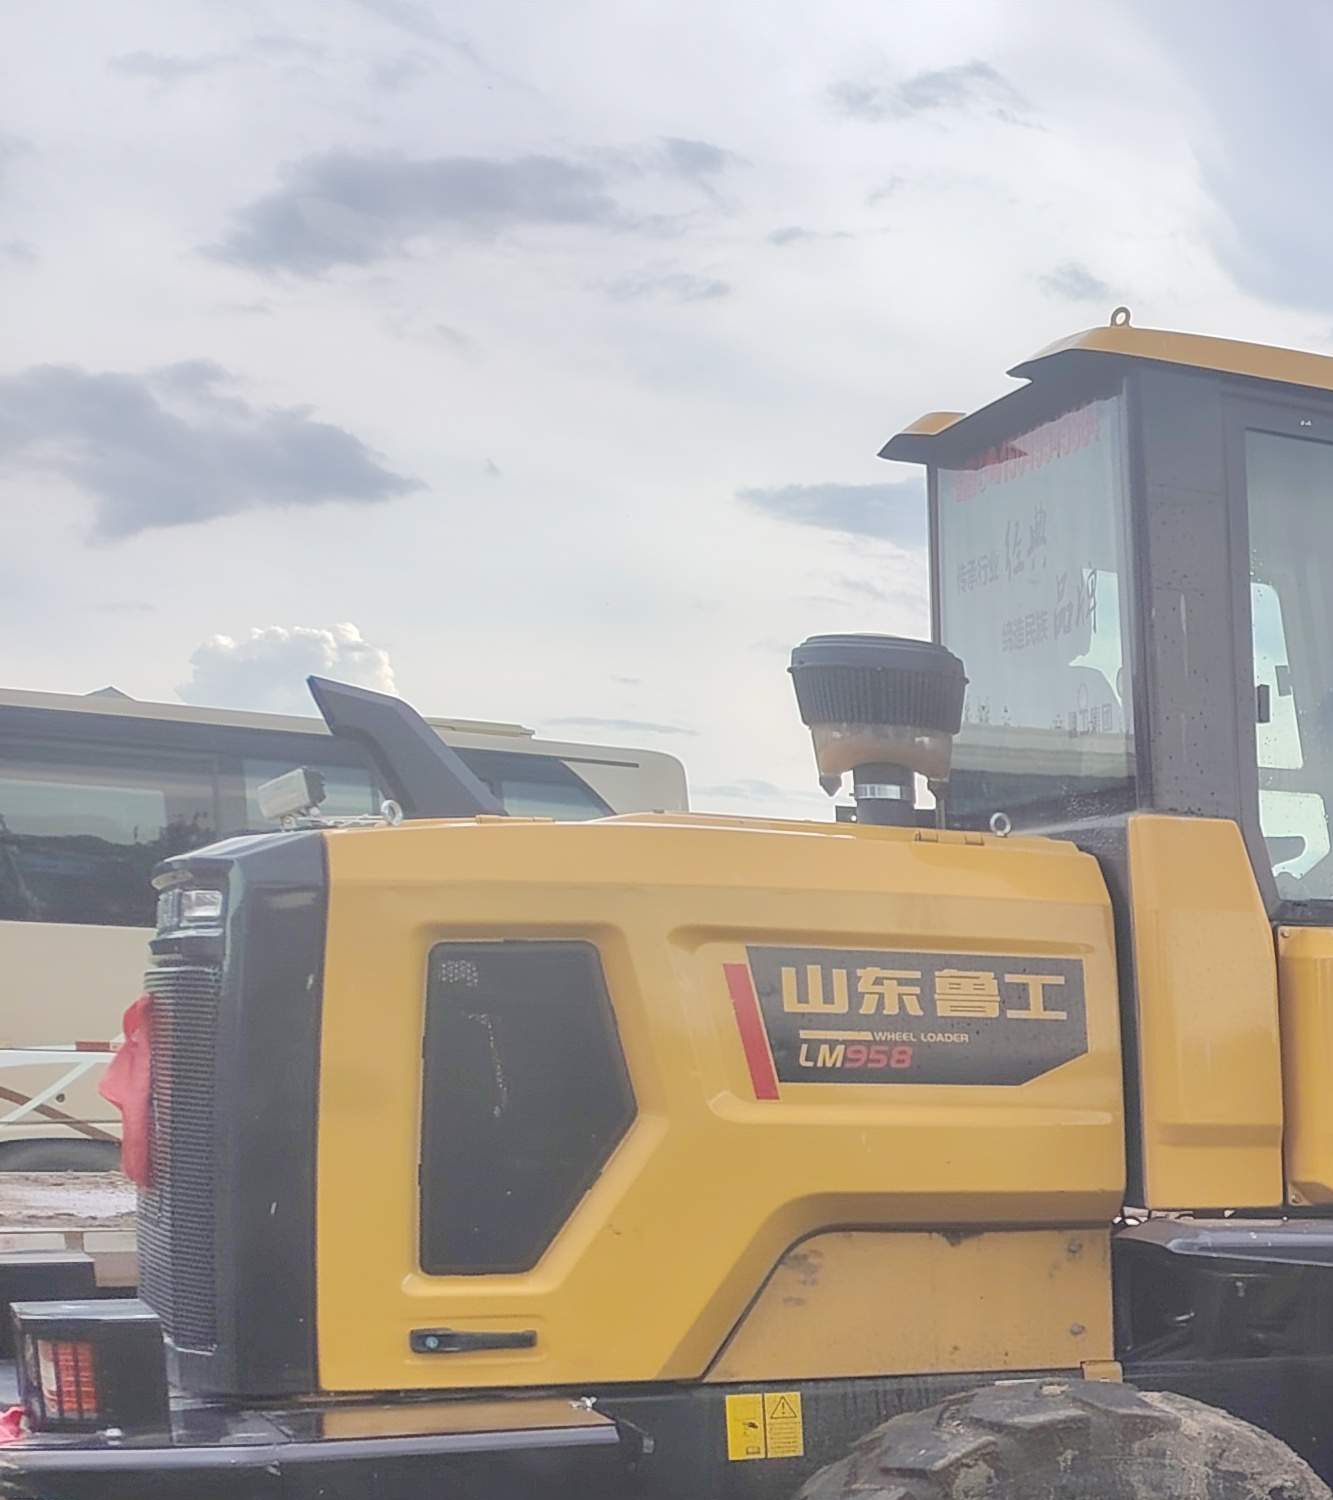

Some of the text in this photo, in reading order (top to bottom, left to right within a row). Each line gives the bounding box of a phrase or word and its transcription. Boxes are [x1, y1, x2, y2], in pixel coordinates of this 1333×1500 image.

[781, 965, 1068, 1021] 山东鲁工
[873, 1030, 969, 1044] WHEEL LOADER
[799, 1044, 913, 1069] LM958
